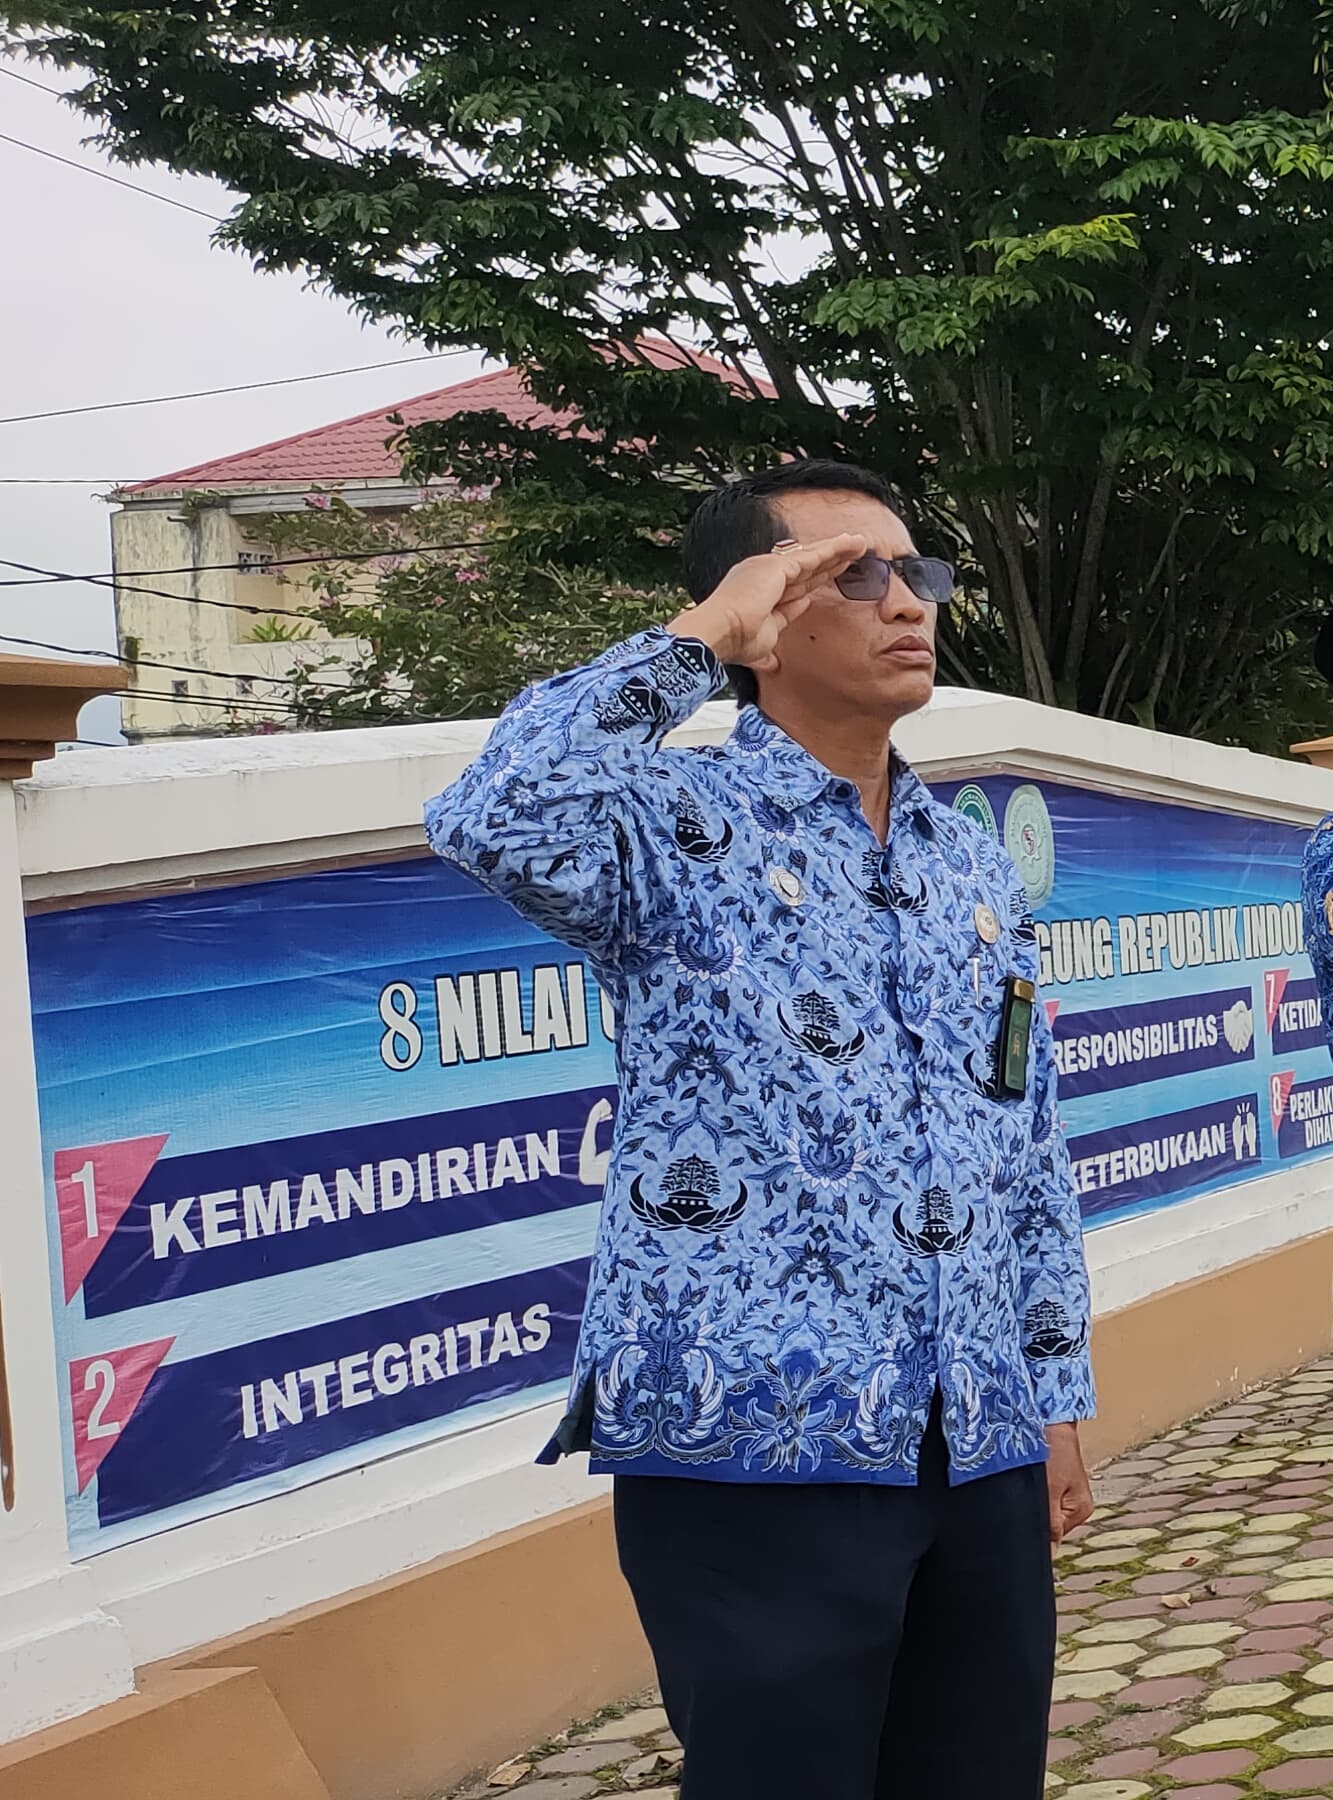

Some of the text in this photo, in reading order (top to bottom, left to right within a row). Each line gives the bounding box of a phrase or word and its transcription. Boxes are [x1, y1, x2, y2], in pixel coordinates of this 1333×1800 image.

[1117, 906, 1241, 977] REPUBLIK
[379, 981, 423, 1072] 8
[434, 961, 589, 1067] NILAI
[1053, 1014, 1218, 1076] RESPONSIBILITAS
[1272, 1076, 1282, 1116] 8
[71, 1128, 561, 1261] 1 KEMANDIRIAN
[1070, 1122, 1227, 1195] KETERBUKAAN
[84, 1302, 552, 1441] 2 INTEGRITAS
